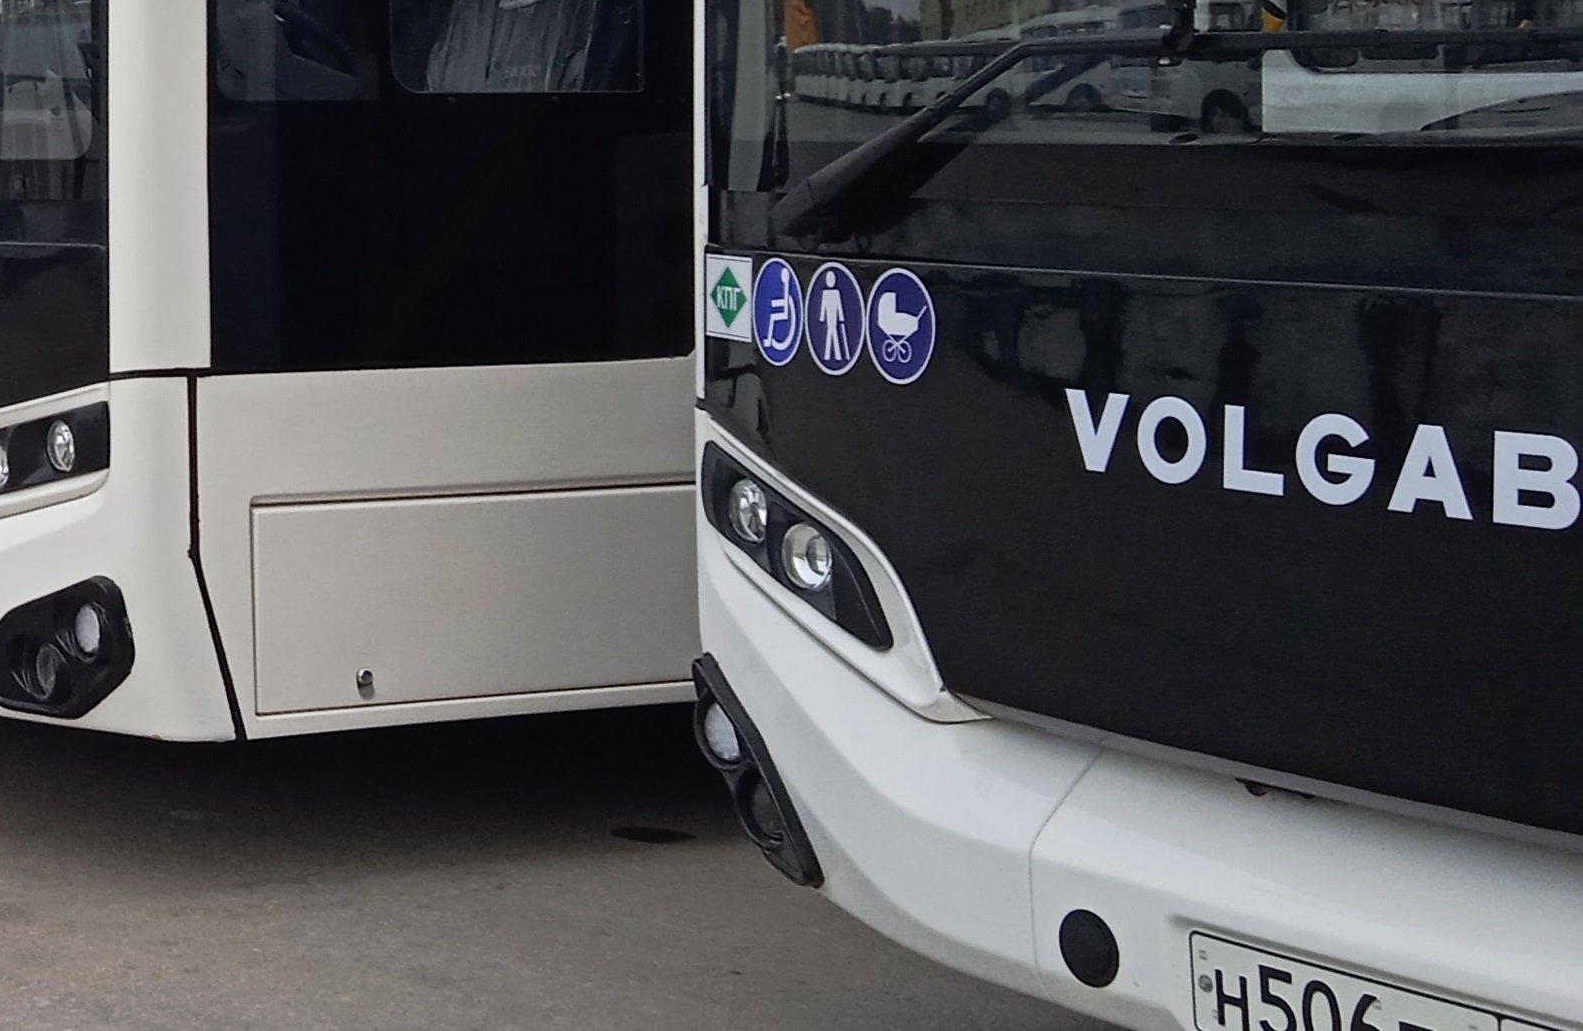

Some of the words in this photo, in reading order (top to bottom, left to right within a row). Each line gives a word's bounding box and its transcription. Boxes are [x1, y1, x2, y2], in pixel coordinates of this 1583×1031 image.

[716, 285, 741, 311] КПГ
[1064, 388, 1581, 530] VOLGAB
[1214, 964, 1434, 1030] Н506
